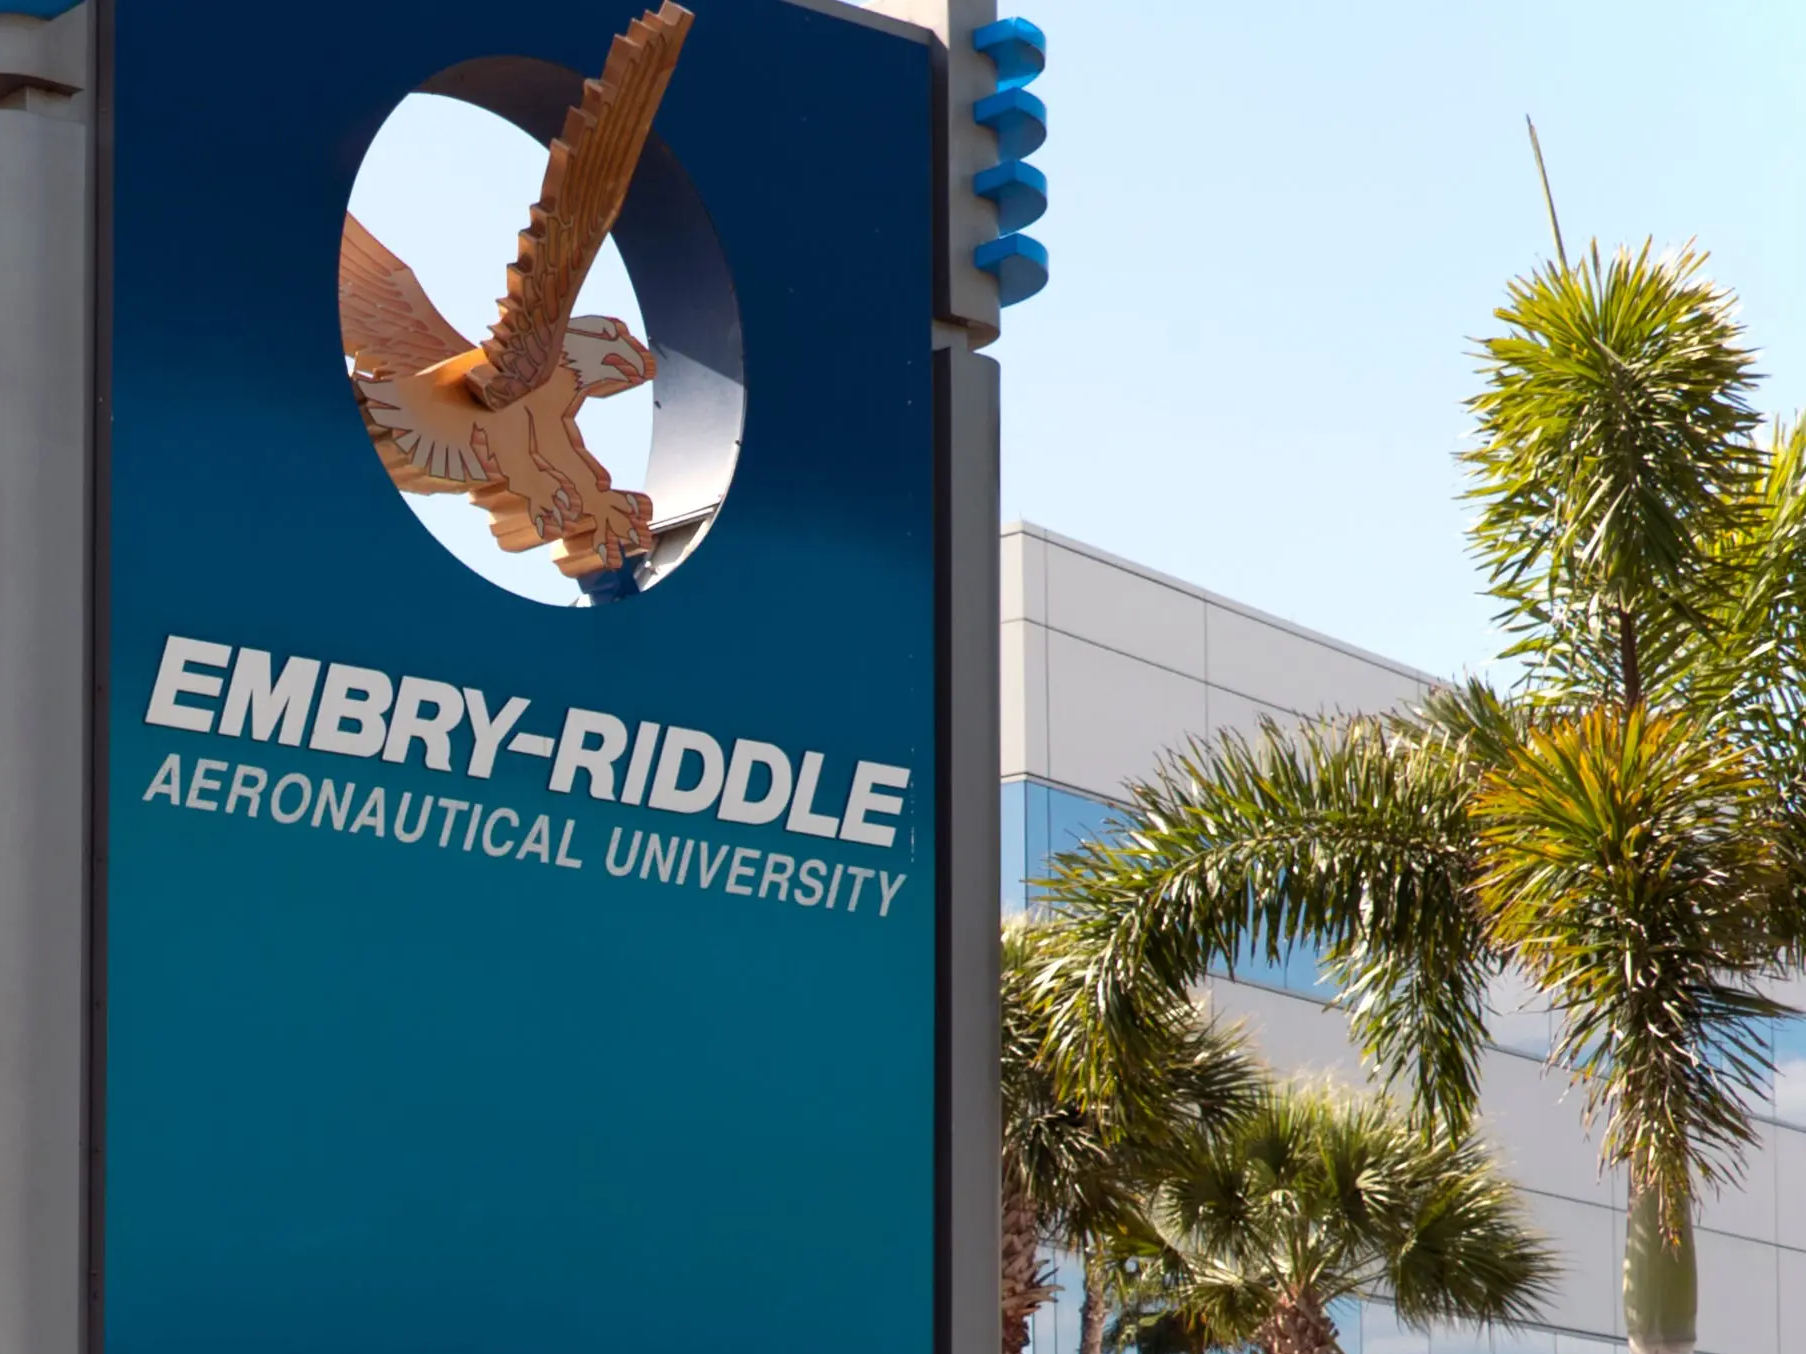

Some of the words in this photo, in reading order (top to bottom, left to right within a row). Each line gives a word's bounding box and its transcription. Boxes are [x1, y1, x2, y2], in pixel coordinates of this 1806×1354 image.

[142, 753, 583, 870] AERONAUTICAL
[605, 826, 906, 918] UNIVERSITY
[144, 634, 911, 848] EMBRY-RIDDLE
